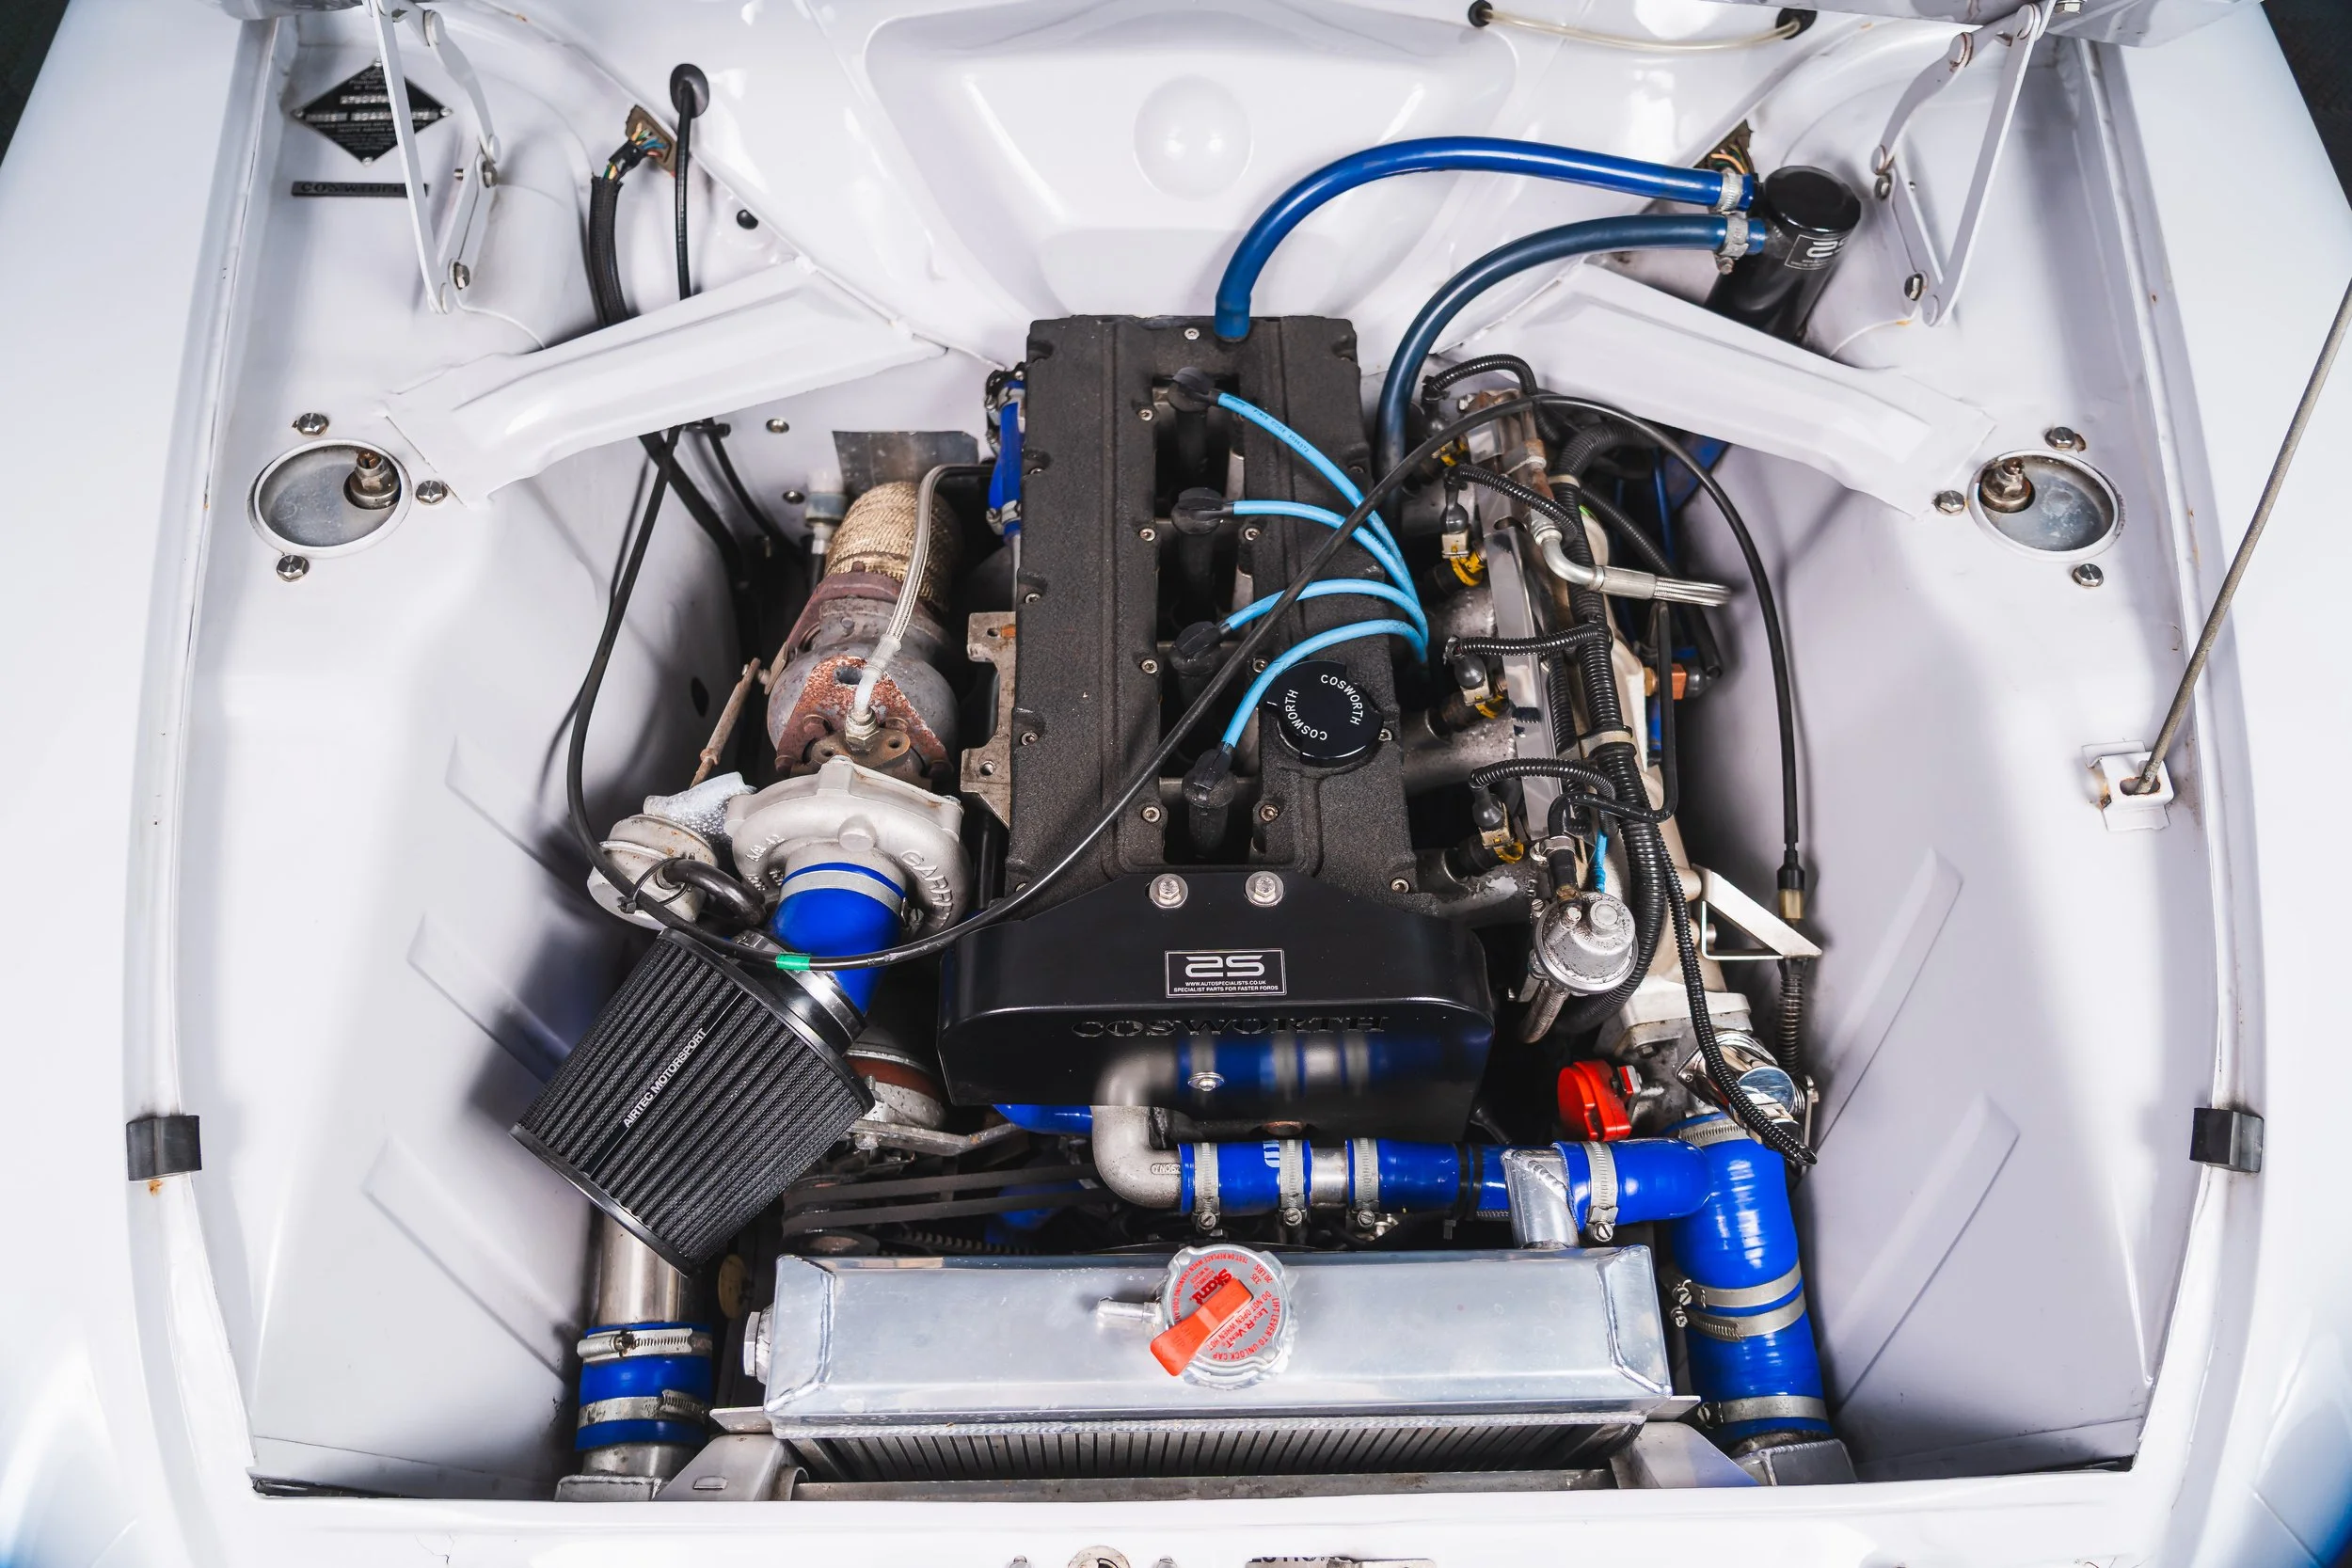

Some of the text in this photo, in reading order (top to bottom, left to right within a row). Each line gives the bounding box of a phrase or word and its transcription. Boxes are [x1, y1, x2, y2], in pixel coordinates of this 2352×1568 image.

[1320, 674, 1363, 725] COSWORTH
[1285, 689, 1327, 741] COSWORTH
[1071, 1017, 1389, 1037] COSWORTH
[623, 1027, 707, 1128] AIRTEC MOTORSPORT
[1189, 1259, 1203, 1271] WHEN
[1204, 1253, 1227, 1262] REPLACE
[1235, 1255, 1248, 1264] TEST
[1250, 1274, 1261, 1285] 335
[1254, 1263, 1272, 1283] 20 LBS
[1174, 1271, 1190, 1296] CHANGING
[1262, 1291, 1272, 1301] DO
[1251, 1299, 1263, 1312] NOT
[1235, 1309, 1252, 1324] OPEN
[1213, 1297, 1280, 1361] LIFT LEVER TO UNLOCK CAP
[1218, 1323, 1237, 1339] WHEN
